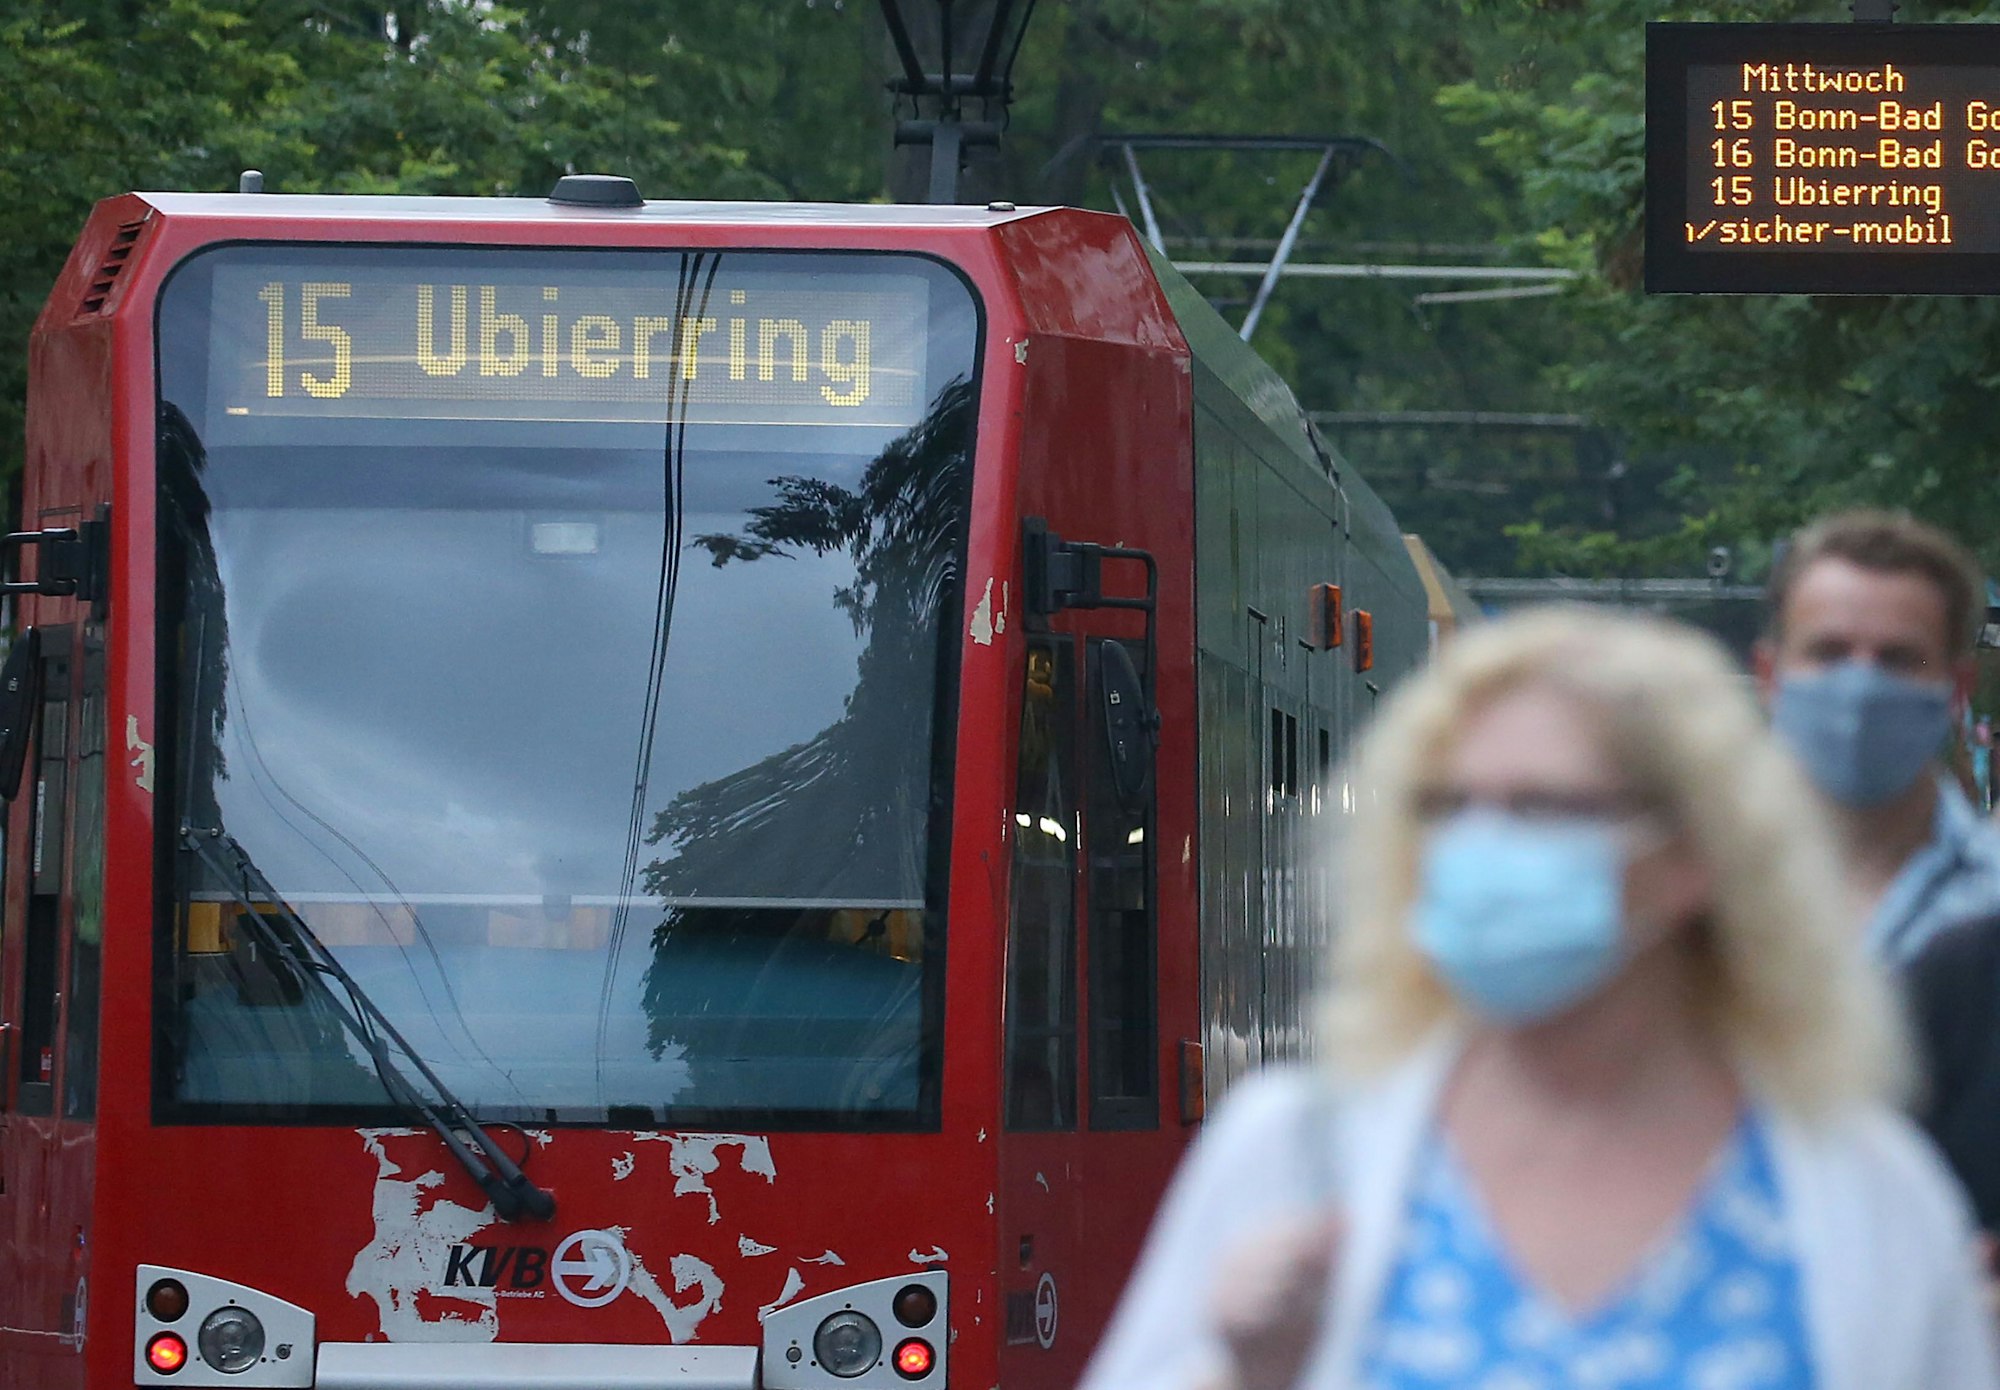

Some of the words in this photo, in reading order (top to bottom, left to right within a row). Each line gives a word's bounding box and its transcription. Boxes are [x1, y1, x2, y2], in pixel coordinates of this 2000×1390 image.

[1743, 62, 1904, 93] Mittwoch
[1711, 100, 1753, 130] 15
[1775, 100, 1942, 131] Bonn-Bad
[1711, 138, 1753, 168] 16
[1775, 138, 1942, 169] Bonn-Bad
[1711, 175, 1753, 206] 15
[1774, 176, 1942, 215] Ubierring
[259, 282, 352, 398] 15
[416, 284, 870, 407] Ubierring
[443, 1244, 548, 1289] KVB
